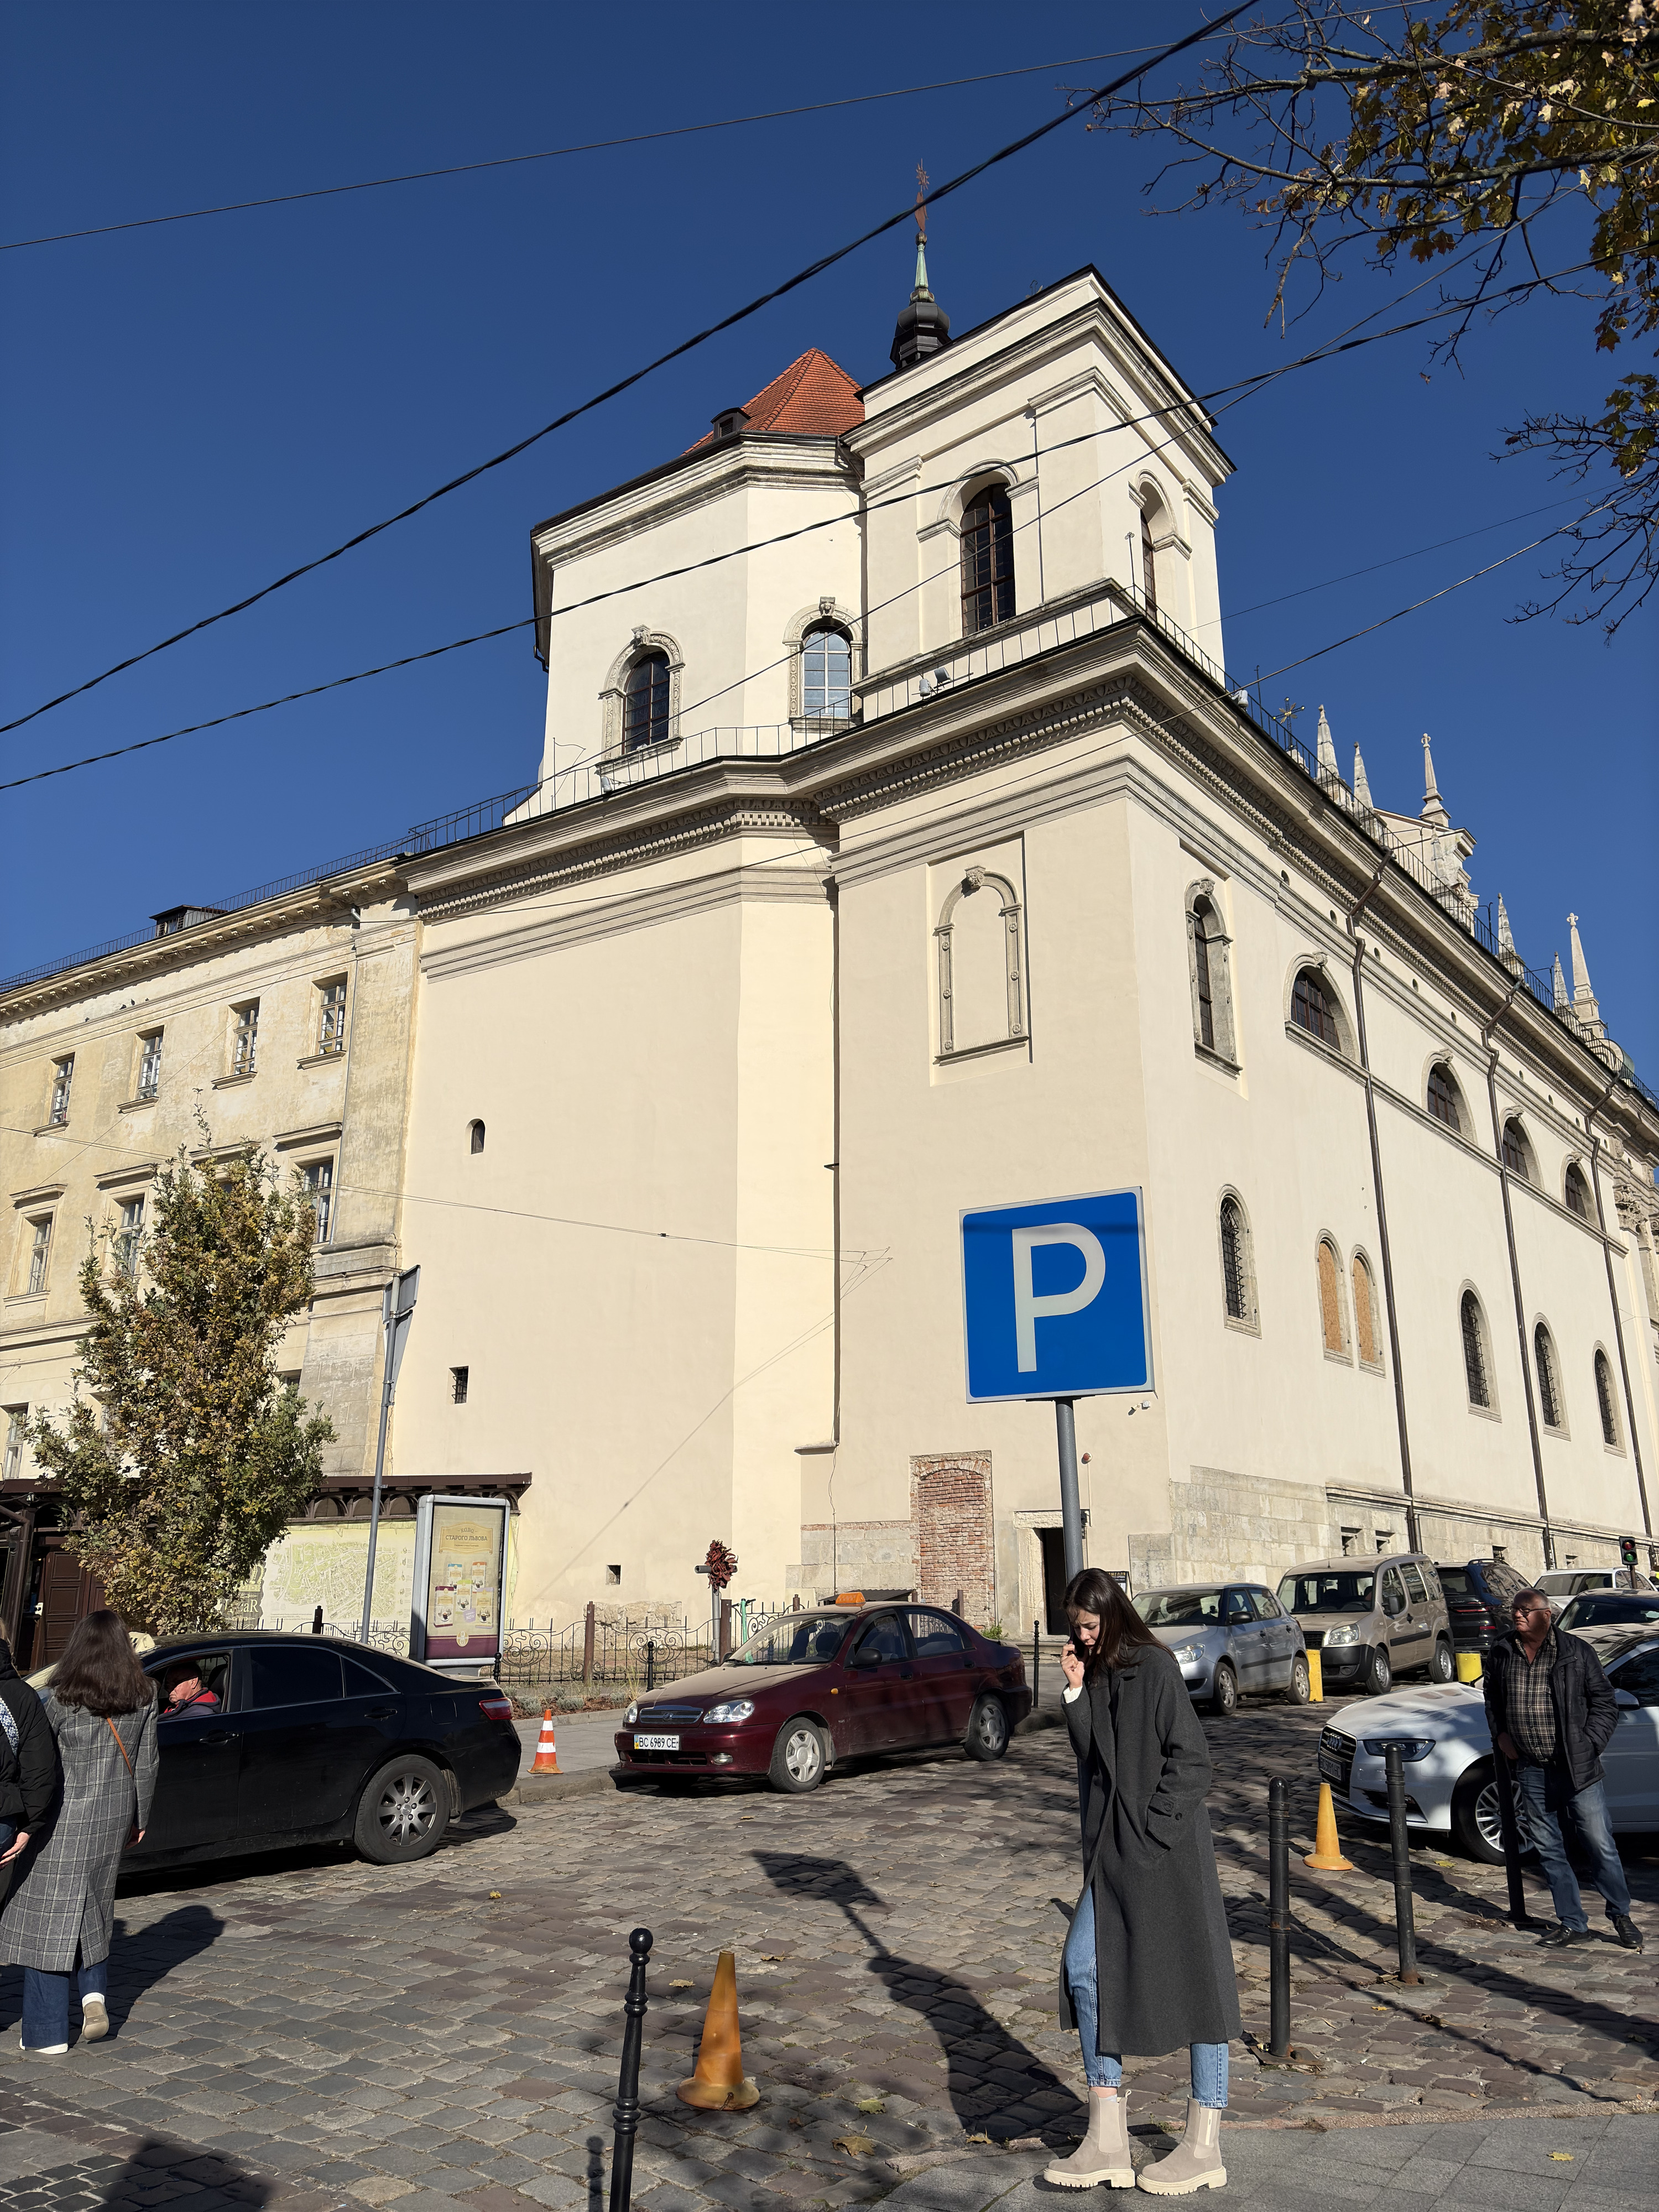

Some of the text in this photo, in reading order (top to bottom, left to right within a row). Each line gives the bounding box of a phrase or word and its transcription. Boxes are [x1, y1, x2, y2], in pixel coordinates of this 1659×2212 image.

[1012, 1222, 1106, 1373] P
[639, 1737, 676, 1748] BC 6989 CE
